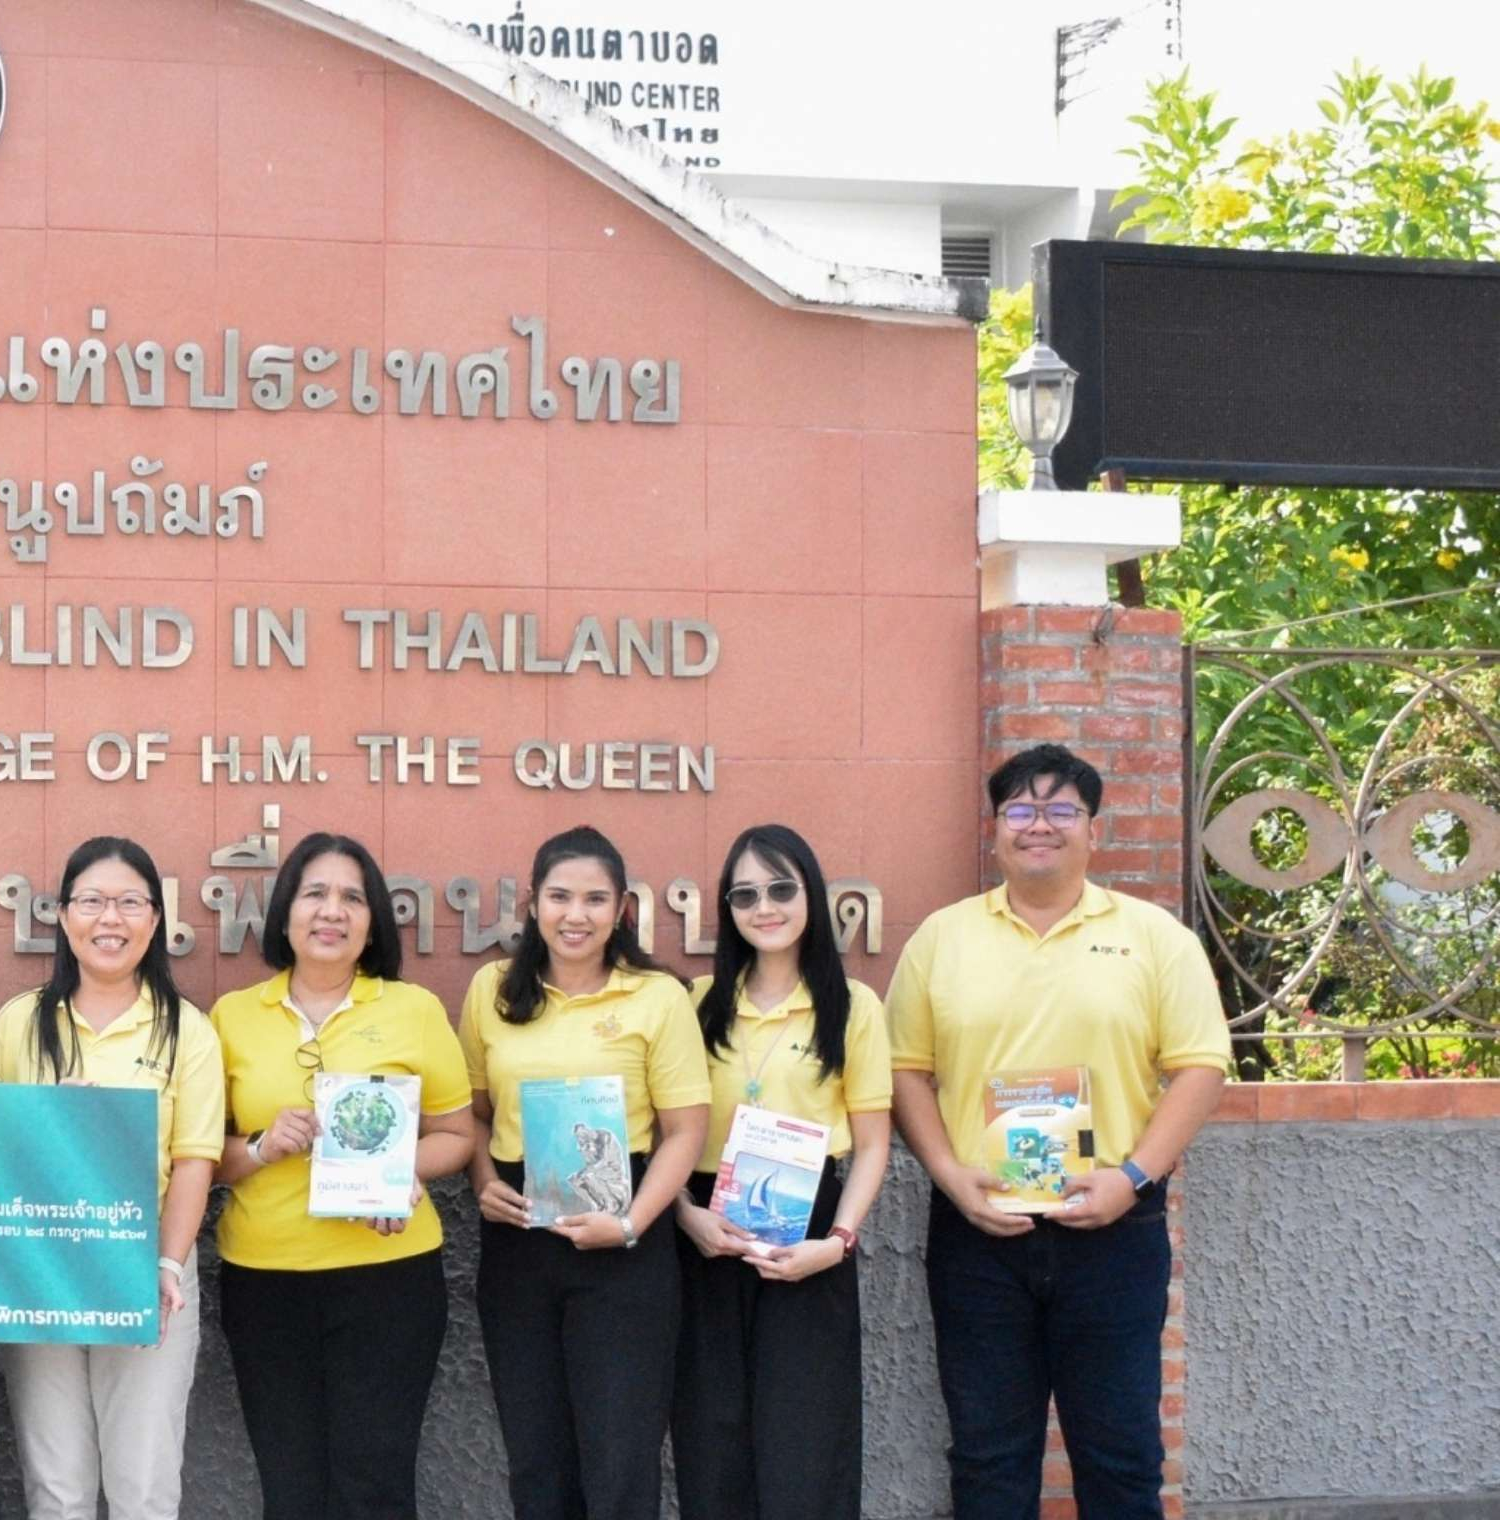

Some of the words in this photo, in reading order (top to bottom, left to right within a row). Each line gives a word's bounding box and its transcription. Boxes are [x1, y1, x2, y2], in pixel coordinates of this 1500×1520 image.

[631, 82, 721, 112] CENTER
[232, 606, 307, 668] IN
[343, 607, 720, 678] THAILAND
[86, 732, 170, 782] OF
[200, 735, 329, 784] H.M.
[357, 736, 482, 785] THE
[514, 739, 716, 792] QUEEN
[49, 1228, 104, 1243] กรกฎาคม
